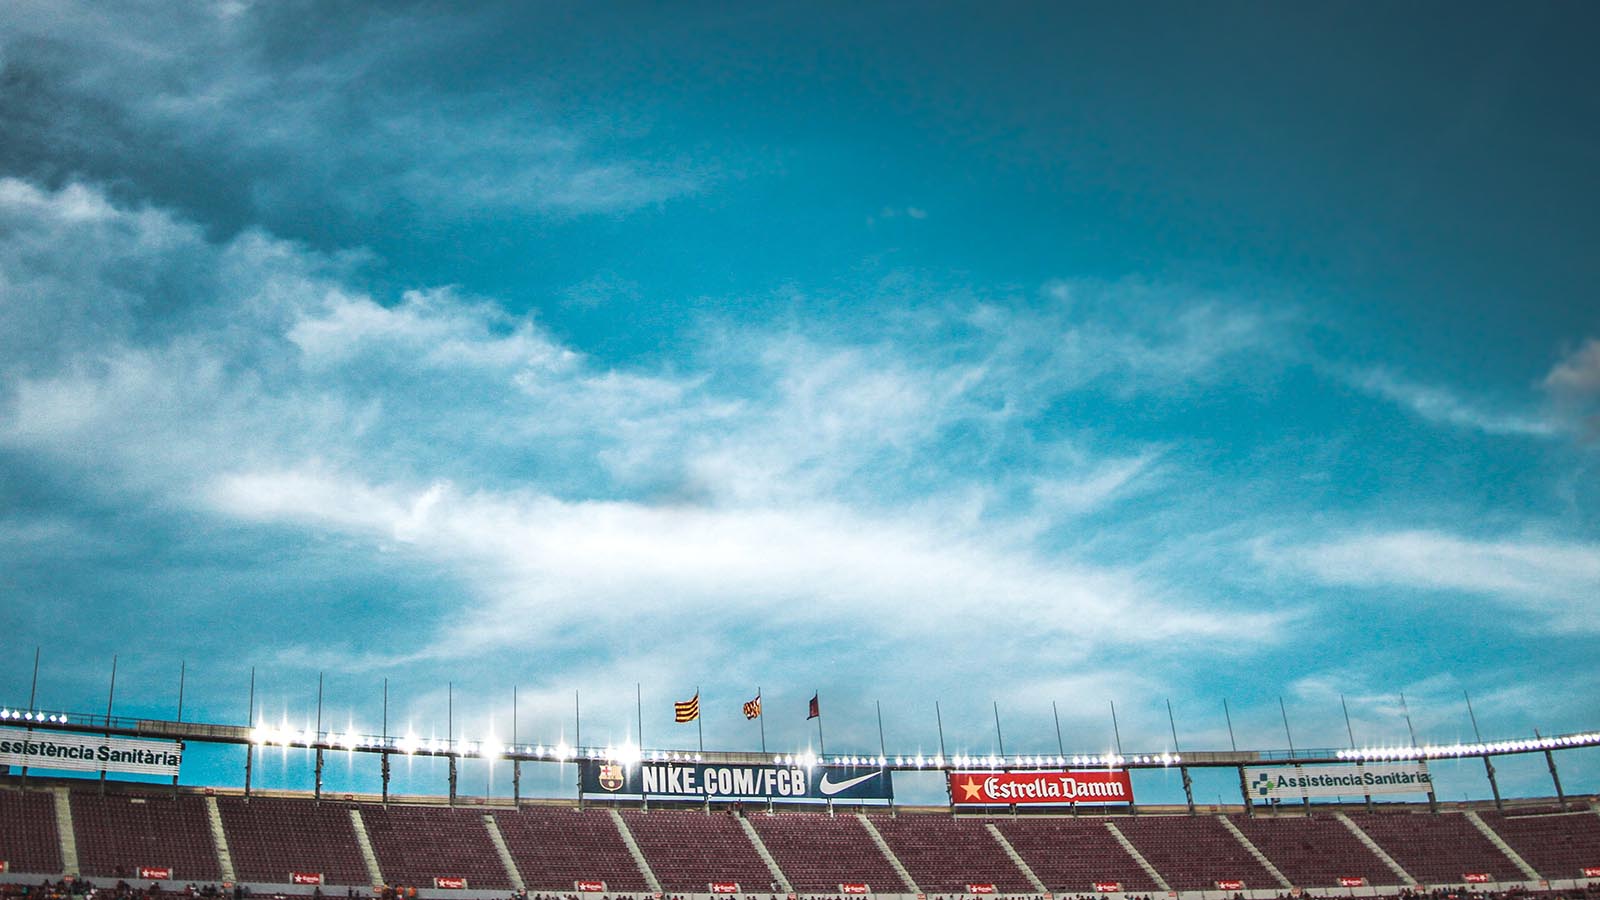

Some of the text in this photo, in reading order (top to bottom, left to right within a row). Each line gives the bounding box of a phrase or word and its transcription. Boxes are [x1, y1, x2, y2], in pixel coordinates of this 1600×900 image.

[0, 740, 179, 766] ssistència Sanitària
[642, 766, 806, 796] NIKE.COM/FCB
[984, 776, 1125, 799] Estrella Damm
[1277, 771, 1430, 788] Assistència Sanitària
